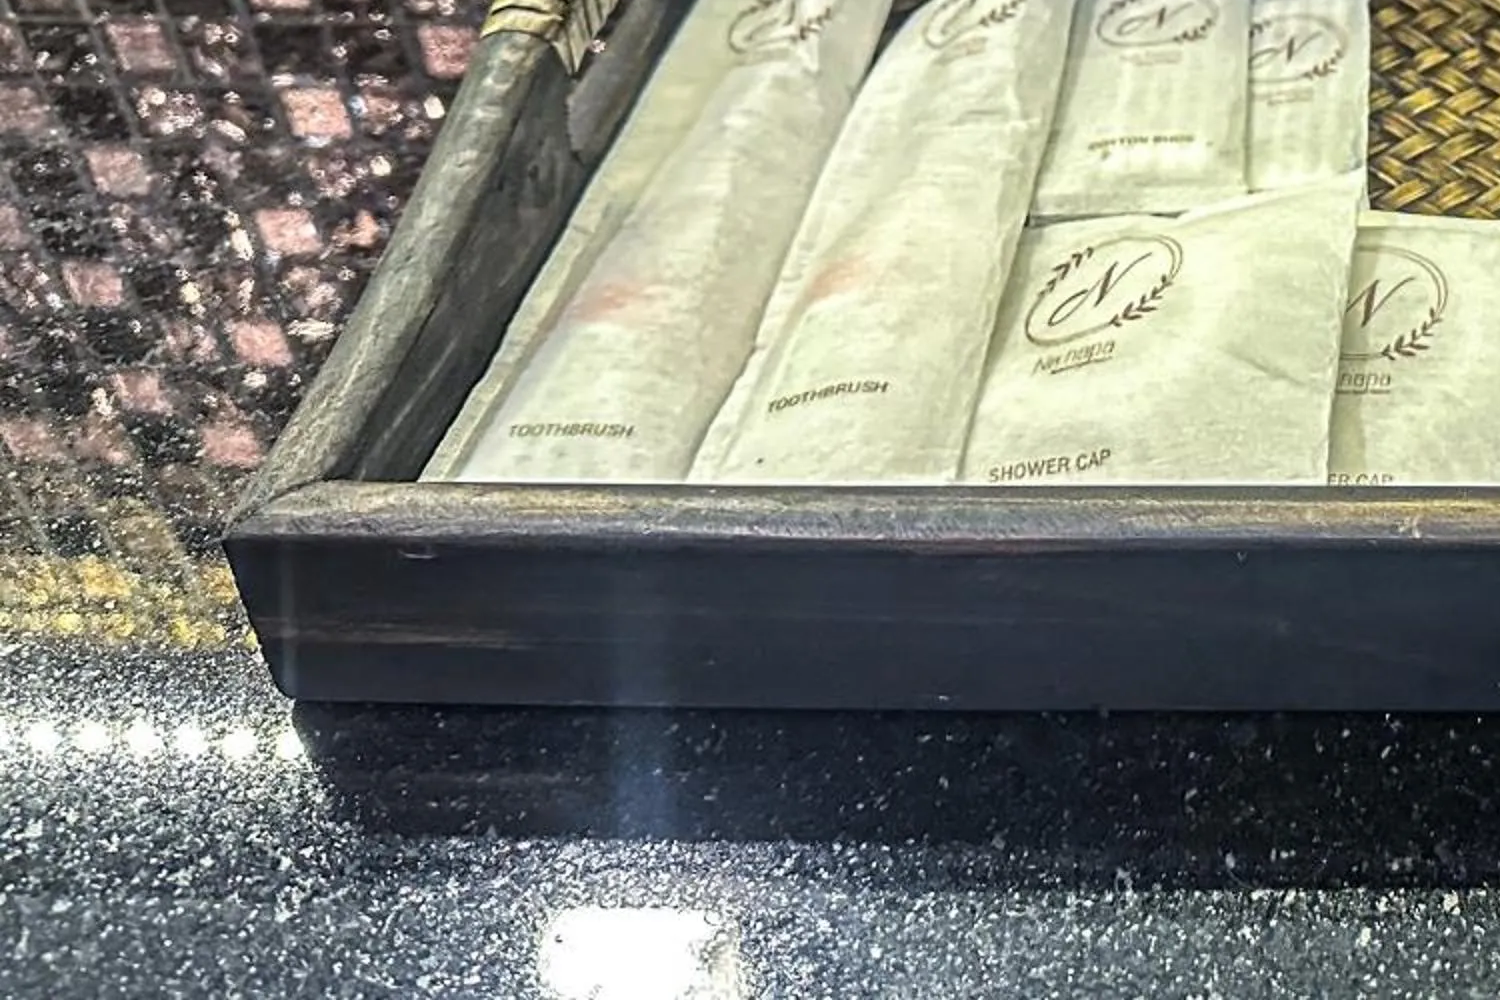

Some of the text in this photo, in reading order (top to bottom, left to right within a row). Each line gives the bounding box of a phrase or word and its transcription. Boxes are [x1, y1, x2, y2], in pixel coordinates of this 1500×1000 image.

[1048, 252, 1152, 327] N
[767, 381, 889, 413] TOOTHBRUSH
[508, 423, 636, 438] TOOTHBRUSH
[989, 448, 1111, 483] SHOWER CAP
